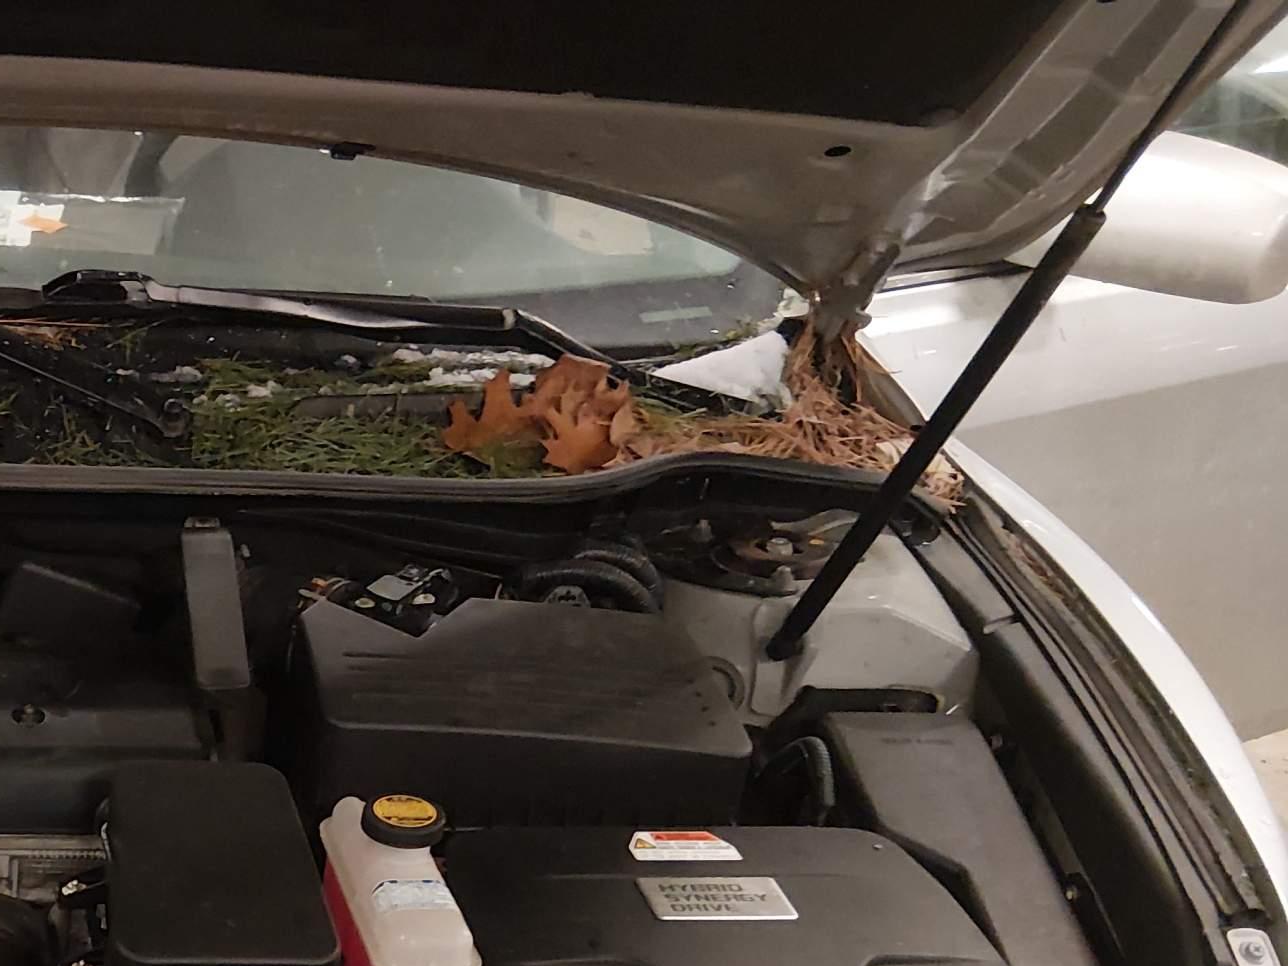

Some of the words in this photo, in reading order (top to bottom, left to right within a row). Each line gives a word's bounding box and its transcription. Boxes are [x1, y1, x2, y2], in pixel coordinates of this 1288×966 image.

[658, 883, 743, 892] HYBRID
[664, 893, 767, 903] SYNERGY
[671, 903, 737, 912] DRIVE
